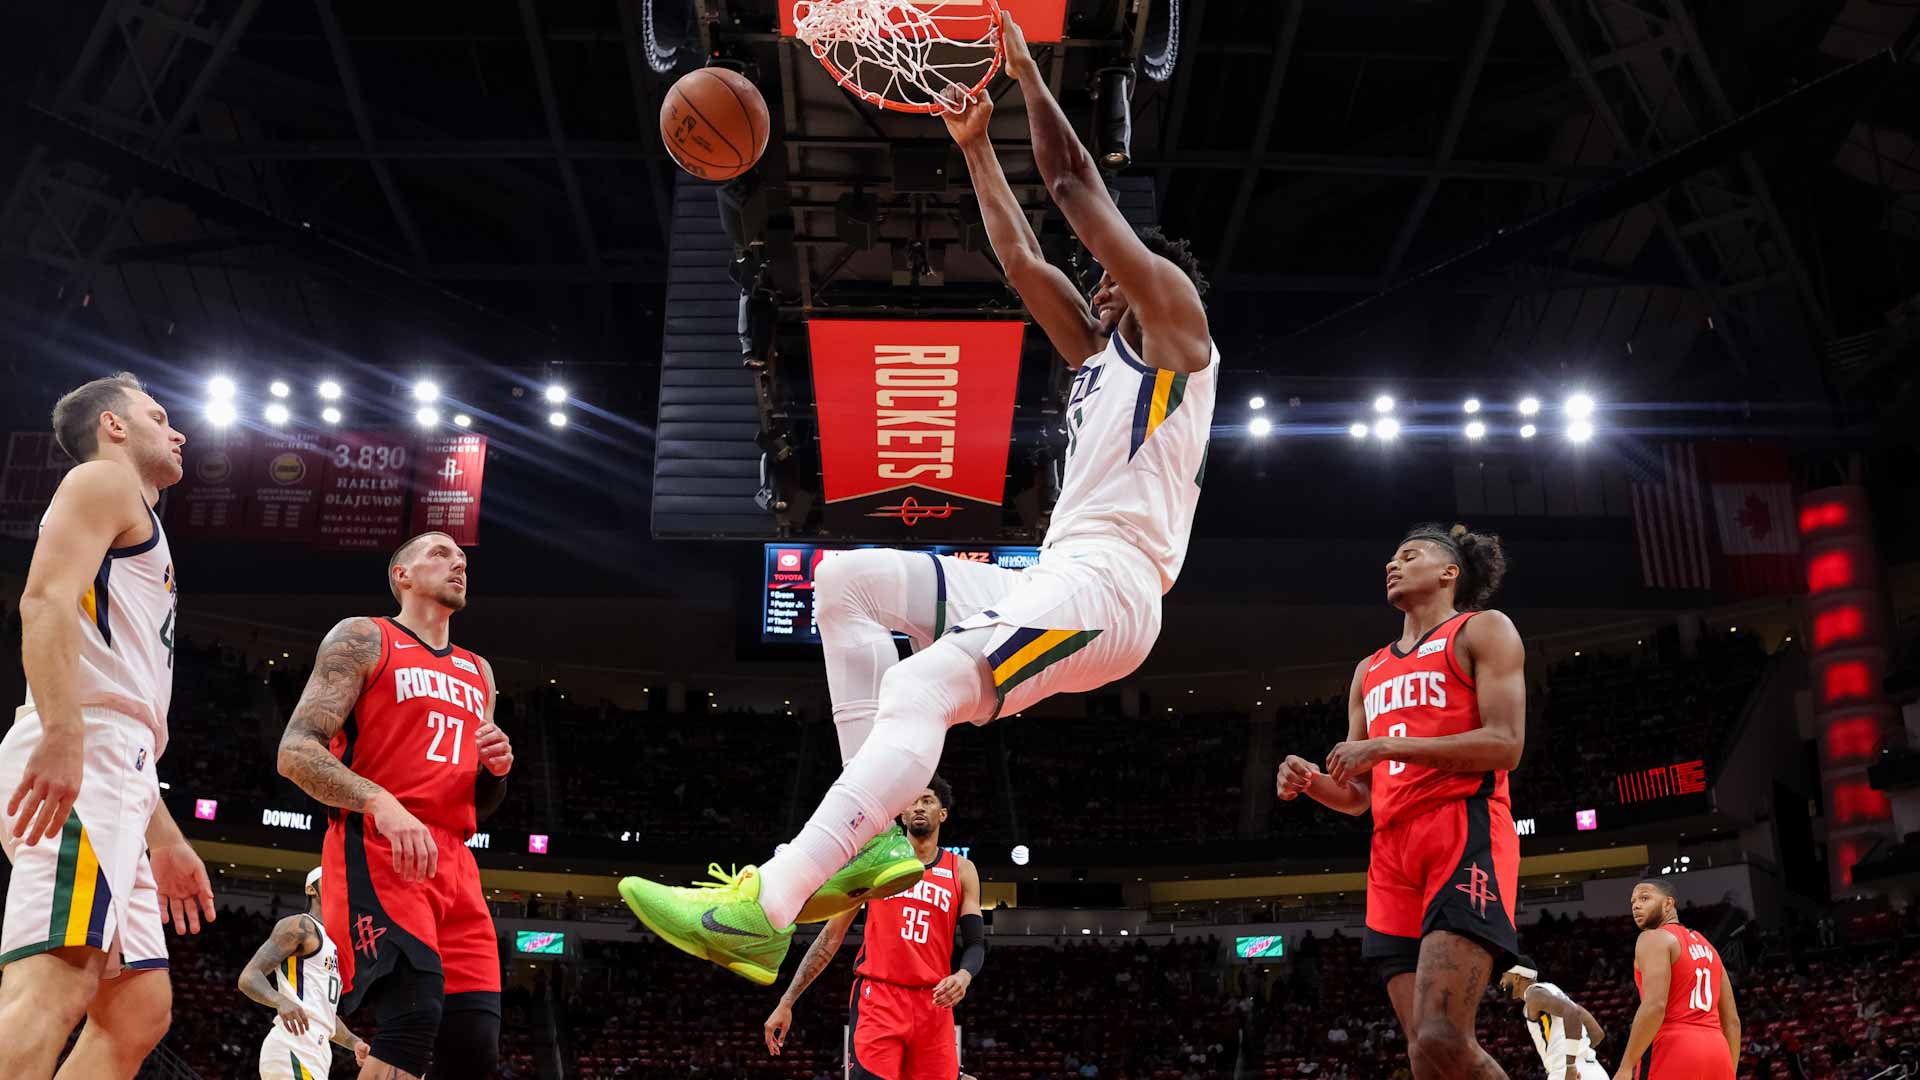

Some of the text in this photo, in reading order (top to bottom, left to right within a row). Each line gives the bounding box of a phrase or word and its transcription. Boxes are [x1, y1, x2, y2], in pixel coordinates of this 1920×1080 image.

[874, 345, 960, 479] ROCKETS
[325, 494, 401, 509] OLAJUWON
[420, 496, 475, 504] CHAMPIONS
[774, 591, 795, 599] Green
[774, 600, 795, 608] Porter
[795, 600, 806, 608] Jr.
[774, 609, 798, 617] Gordon
[773, 626, 793, 634] Wood
[395, 667, 485, 721] ROCKETS
[426, 711, 464, 765] 27
[1513, 818, 1536, 836] AY!
[900, 906, 931, 944] 35
[1689, 967, 1713, 1012] 10
